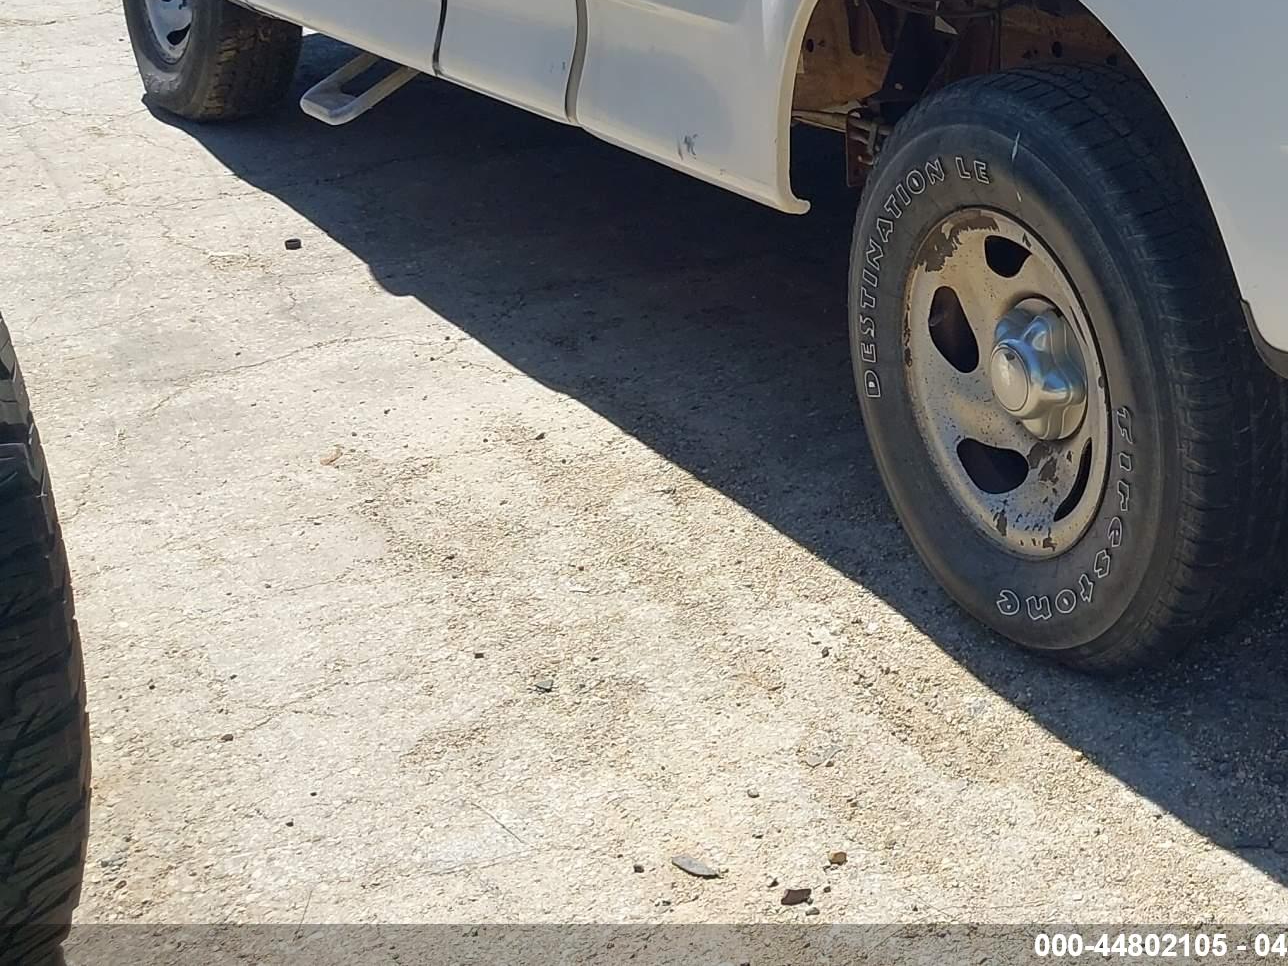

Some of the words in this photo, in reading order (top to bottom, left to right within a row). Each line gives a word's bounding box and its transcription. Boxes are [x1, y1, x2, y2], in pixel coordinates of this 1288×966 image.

[860, 157, 945, 398] DESTINATION
[955, 156, 990, 185] LE
[996, 406, 1135, 621] Firestone
